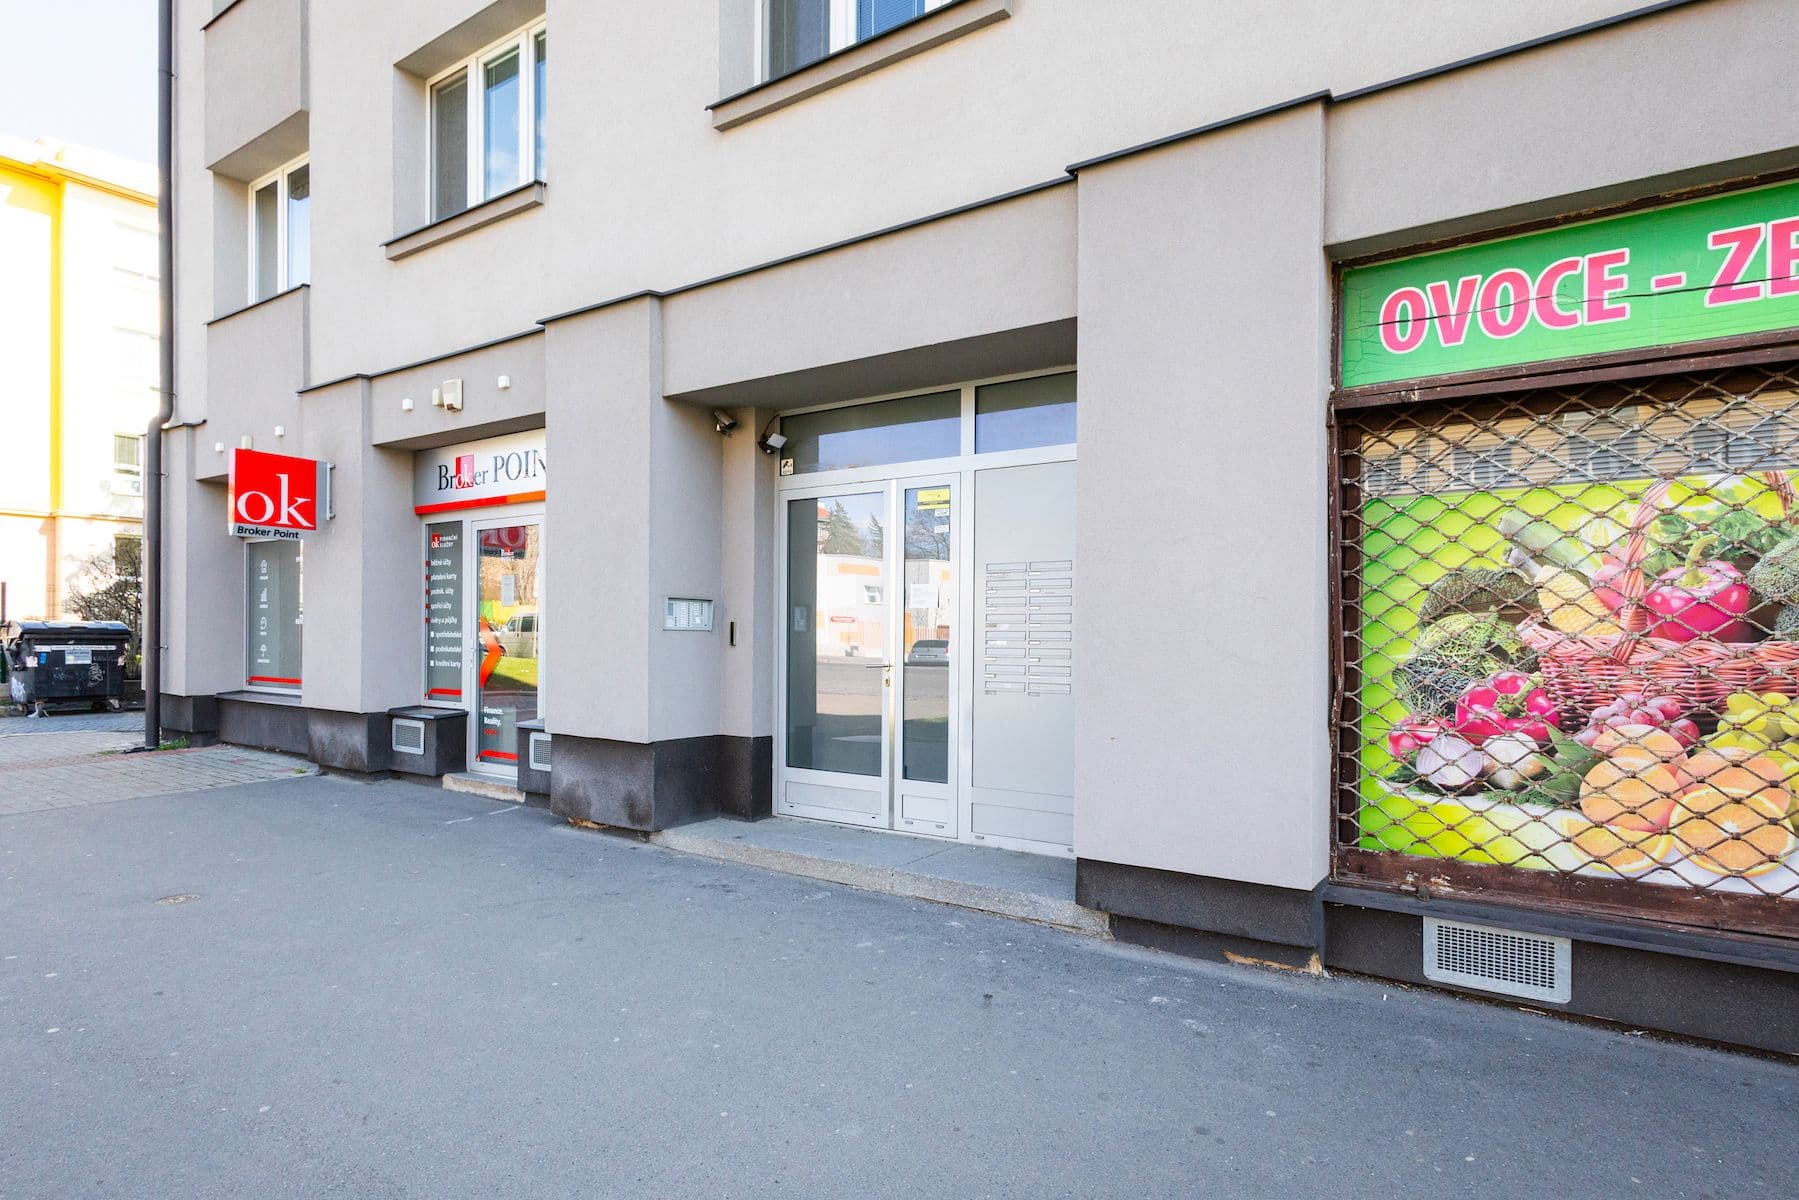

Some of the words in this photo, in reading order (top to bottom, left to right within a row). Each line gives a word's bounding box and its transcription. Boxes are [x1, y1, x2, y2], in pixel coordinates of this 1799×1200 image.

[1379, 248, 1630, 355] OVOCE
[437, 463, 489, 491] Broker
[236, 473, 314, 527] ok
[237, 525, 271, 537] Broker
[273, 528, 299, 539] Point
